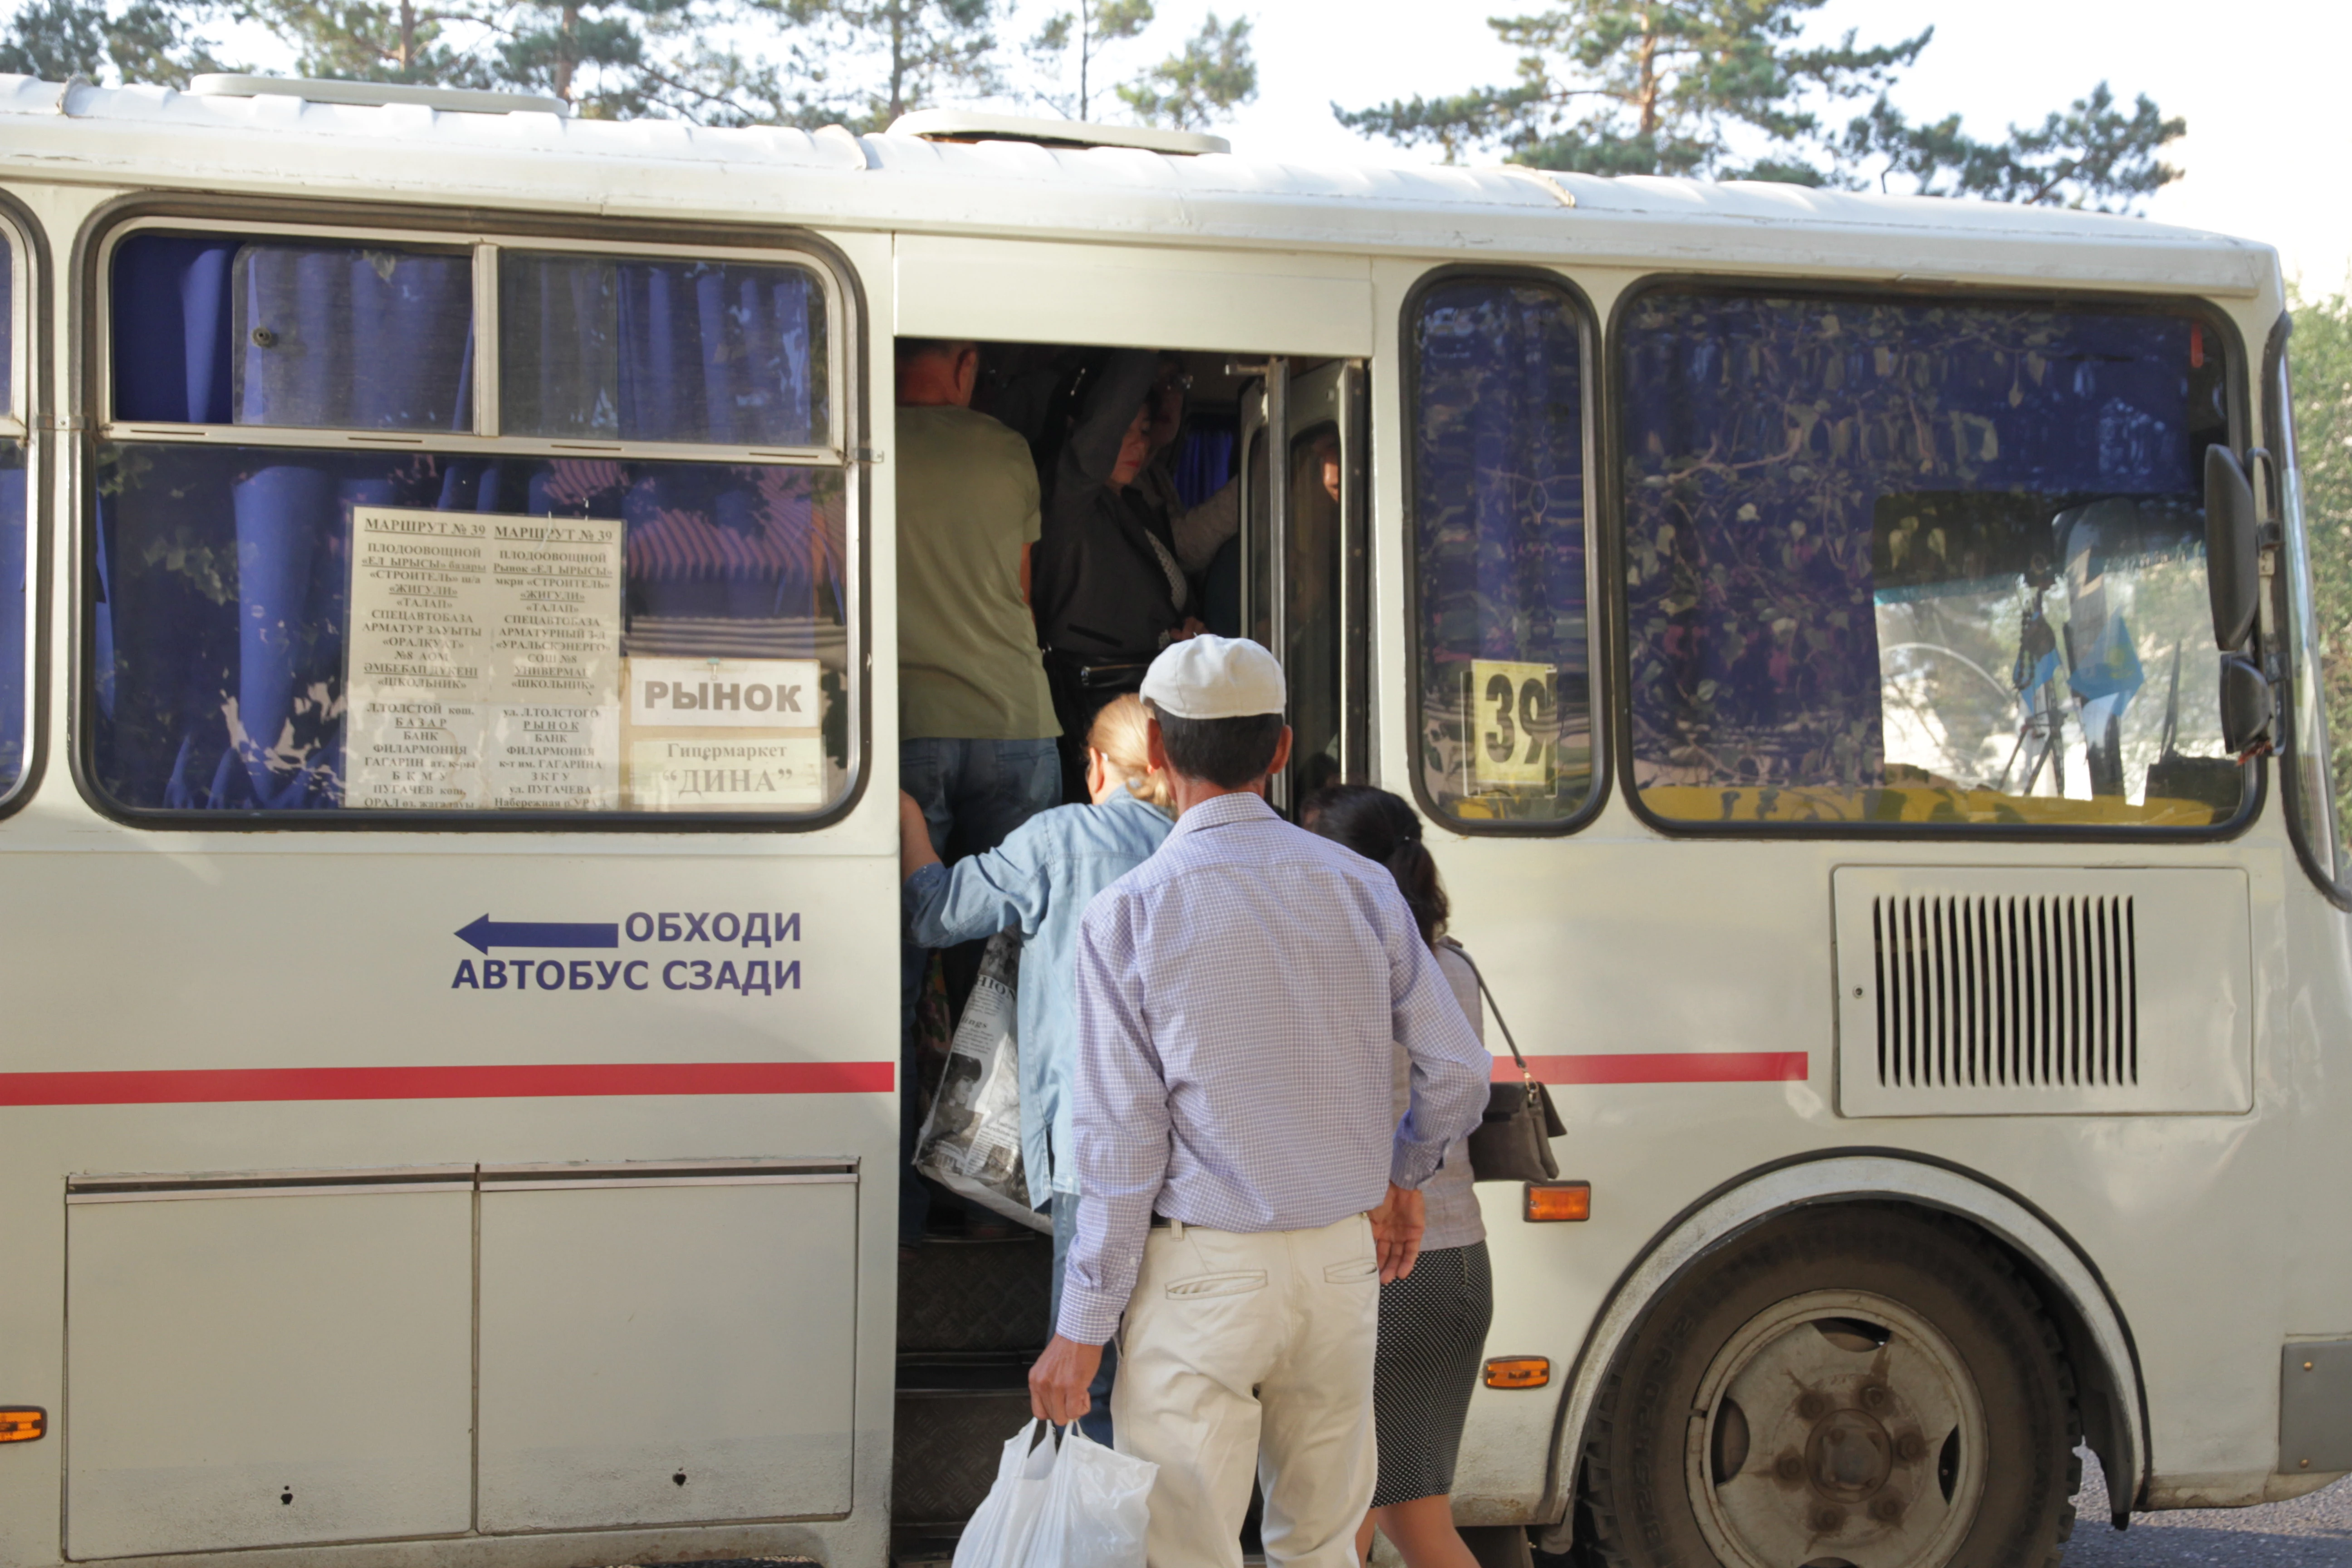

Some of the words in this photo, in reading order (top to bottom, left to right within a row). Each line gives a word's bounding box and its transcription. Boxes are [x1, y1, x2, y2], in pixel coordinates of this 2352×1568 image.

[365, 518, 447, 533] МАРШРУТ
[451, 523, 467, 534] №
[471, 524, 485, 535] 39
[495, 526, 574, 539] МАРШРУТ
[579, 530, 594, 541] №
[598, 530, 612, 541] 39
[368, 543, 481, 558] ПЛОДООВОЩНОЙ
[500, 550, 607, 563] ПЛОДООВОЩНОЙ
[449, 562, 485, 572] базары
[494, 563, 528, 573] Рынок
[370, 570, 458, 582] «СТРОИТЕЛЬ»
[495, 578, 523, 587] мкрн
[527, 578, 610, 588] «СТРОИТЕЛЬ»
[389, 584, 457, 595] «ЖИГУЛИ»
[520, 590, 585, 601] «ЖИГУЛИ»
[397, 598, 452, 608] «ТАЛАП»
[526, 603, 579, 613] «ТАЛАП»
[372, 609, 473, 623] СПЕЦАВТОБАЗА
[504, 615, 601, 627] СПЕЦАВТОБАЗА
[363, 623, 423, 634] АРМАТУР
[426, 626, 481, 636] ЗАУЫТЫ
[500, 628, 584, 639] АРМАТУРНЫЙ
[496, 640, 611, 652] «УРАЛЬСКЭНЕРГО»
[528, 654, 556, 663] СОШ
[378, 677, 466, 689] «ШКОЛЬНИК»
[512, 679, 595, 690] «ШКОЛЬНИК»
[644, 681, 802, 713] РЫНОК
[1485, 674, 1549, 764] 39
[404, 731, 438, 741] БАНК
[535, 734, 567, 743] БАНК
[373, 744, 467, 755] ФИЛАРМОНИЯ
[506, 746, 595, 757] ФИЛАРМОНИЯ
[667, 743, 787, 761] Гипермаркет
[365, 757, 424, 767] ГАГАРИН
[539, 760, 603, 769] ГАГАРИНА
[374, 784, 433, 794] ПУГАЧЕВ
[528, 784, 592, 794] ПУГАЧЕВА
[364, 797, 399, 808] ОРАЛ
[495, 797, 560, 808] Набережная
[625, 912, 801, 948] ОБХОДИ
[451, 959, 649, 990] АВТОБУС
[662, 960, 801, 996] СЗАДИ
